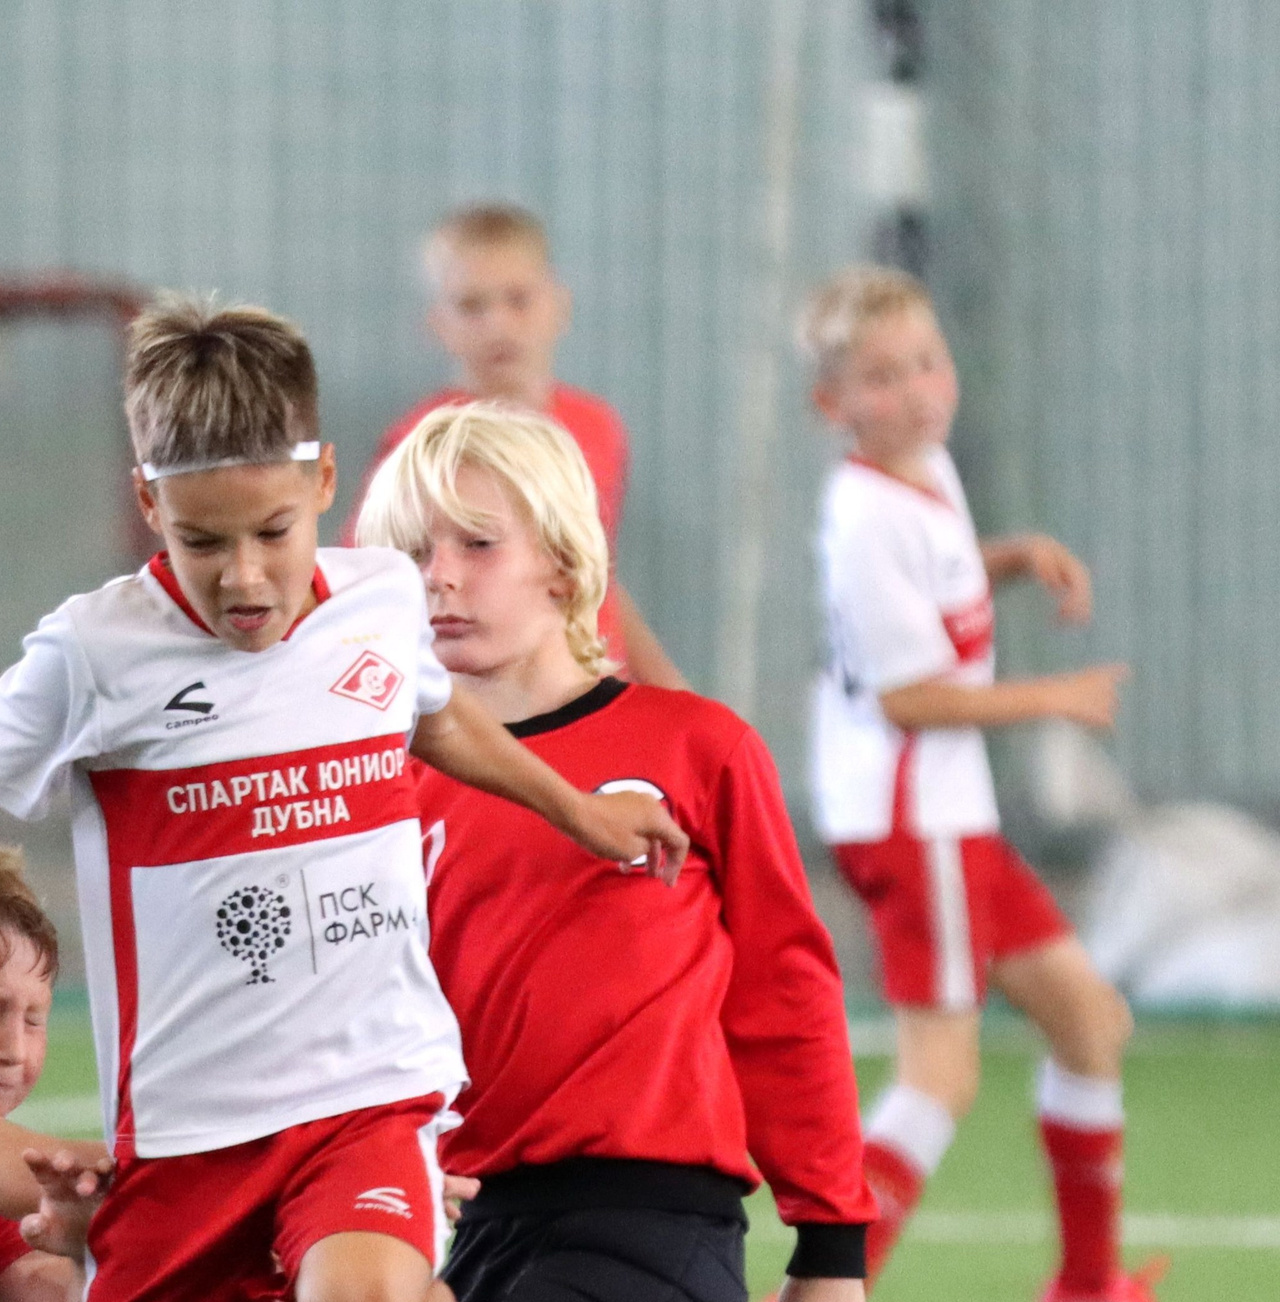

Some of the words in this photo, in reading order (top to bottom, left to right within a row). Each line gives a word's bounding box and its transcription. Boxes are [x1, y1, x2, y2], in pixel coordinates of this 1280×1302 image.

[165, 713, 220, 731] campeo
[166, 765, 310, 814] СПАРТАК
[318, 747, 407, 792] ЮНИОР
[251, 794, 351, 838] ДУБНА
[319, 882, 379, 920] ПСК
[324, 905, 418, 946] ФАРМ
